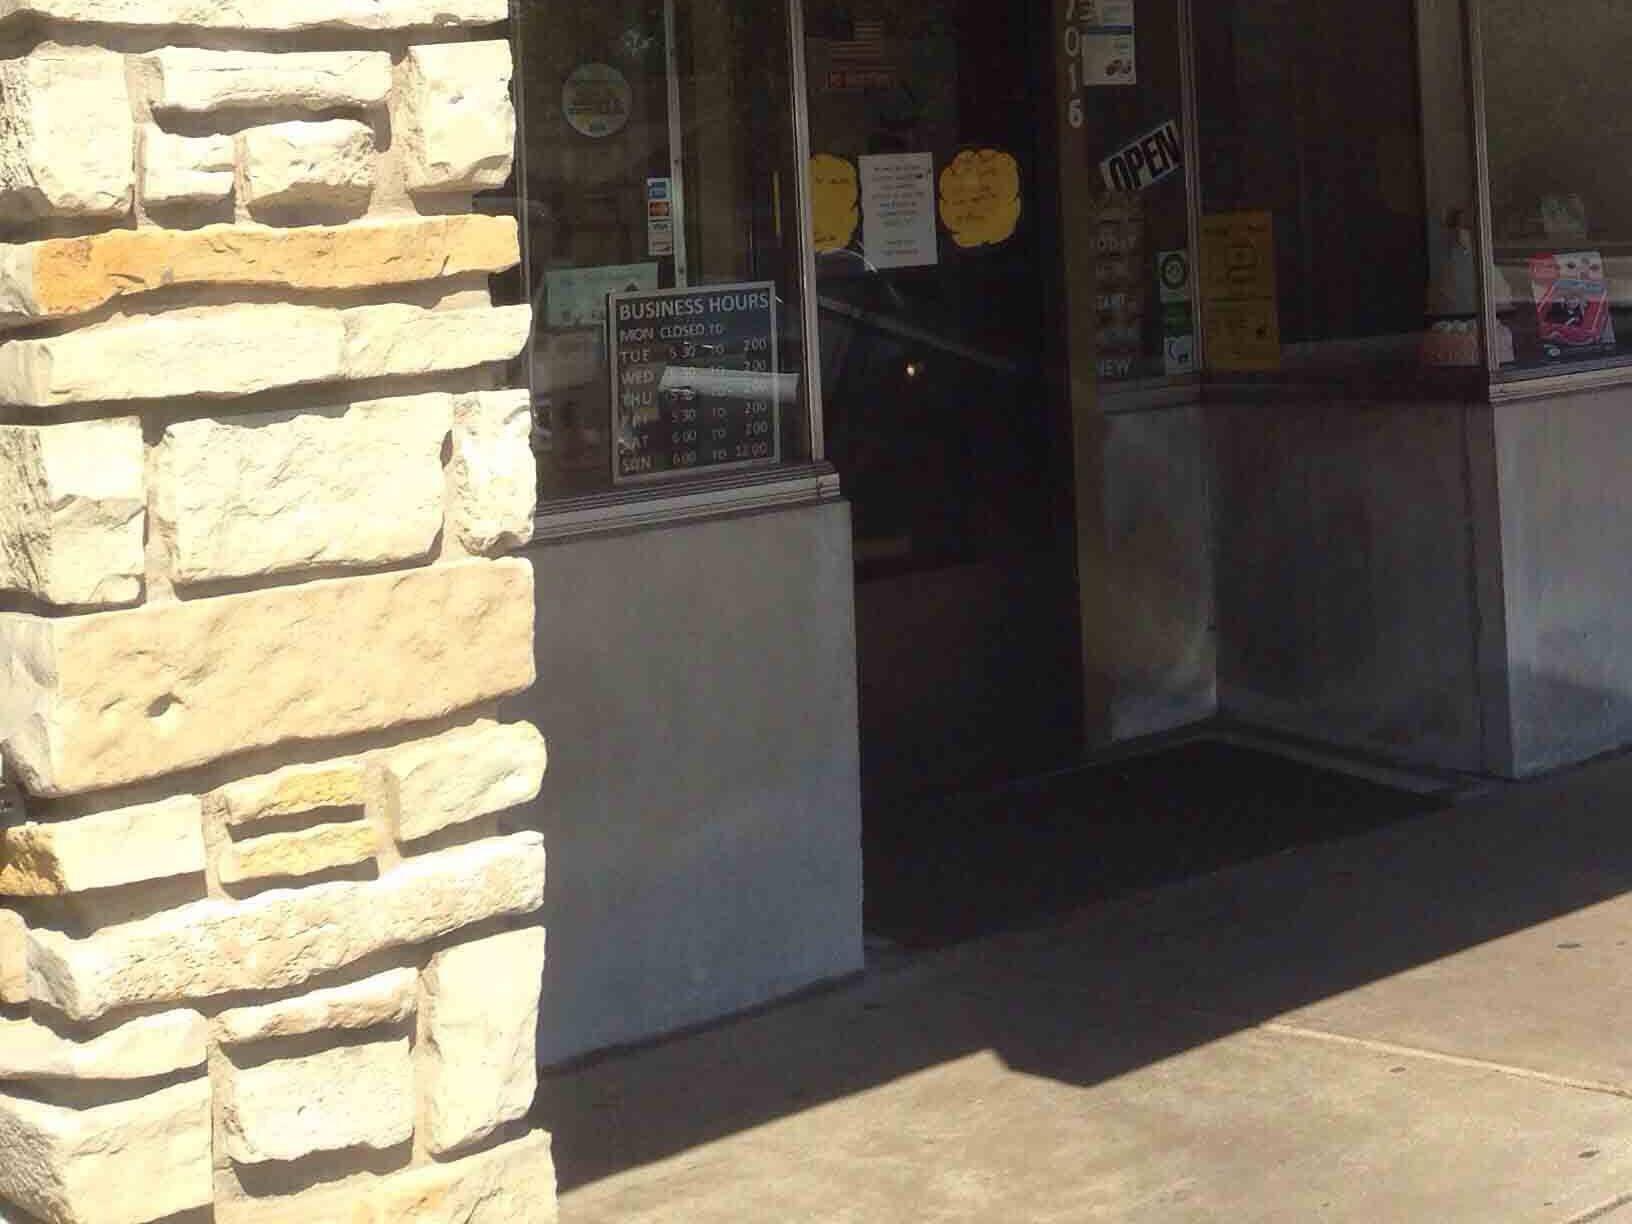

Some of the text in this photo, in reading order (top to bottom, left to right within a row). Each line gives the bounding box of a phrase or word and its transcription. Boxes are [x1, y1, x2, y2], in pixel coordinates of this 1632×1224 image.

[1108, 123, 1182, 192] OPEN
[619, 292, 770, 321] BUSINESS HOURS
[619, 326, 654, 343] MON
[659, 322, 706, 339] CLOSED
[619, 349, 651, 363] TUE
[621, 369, 655, 385] WED
